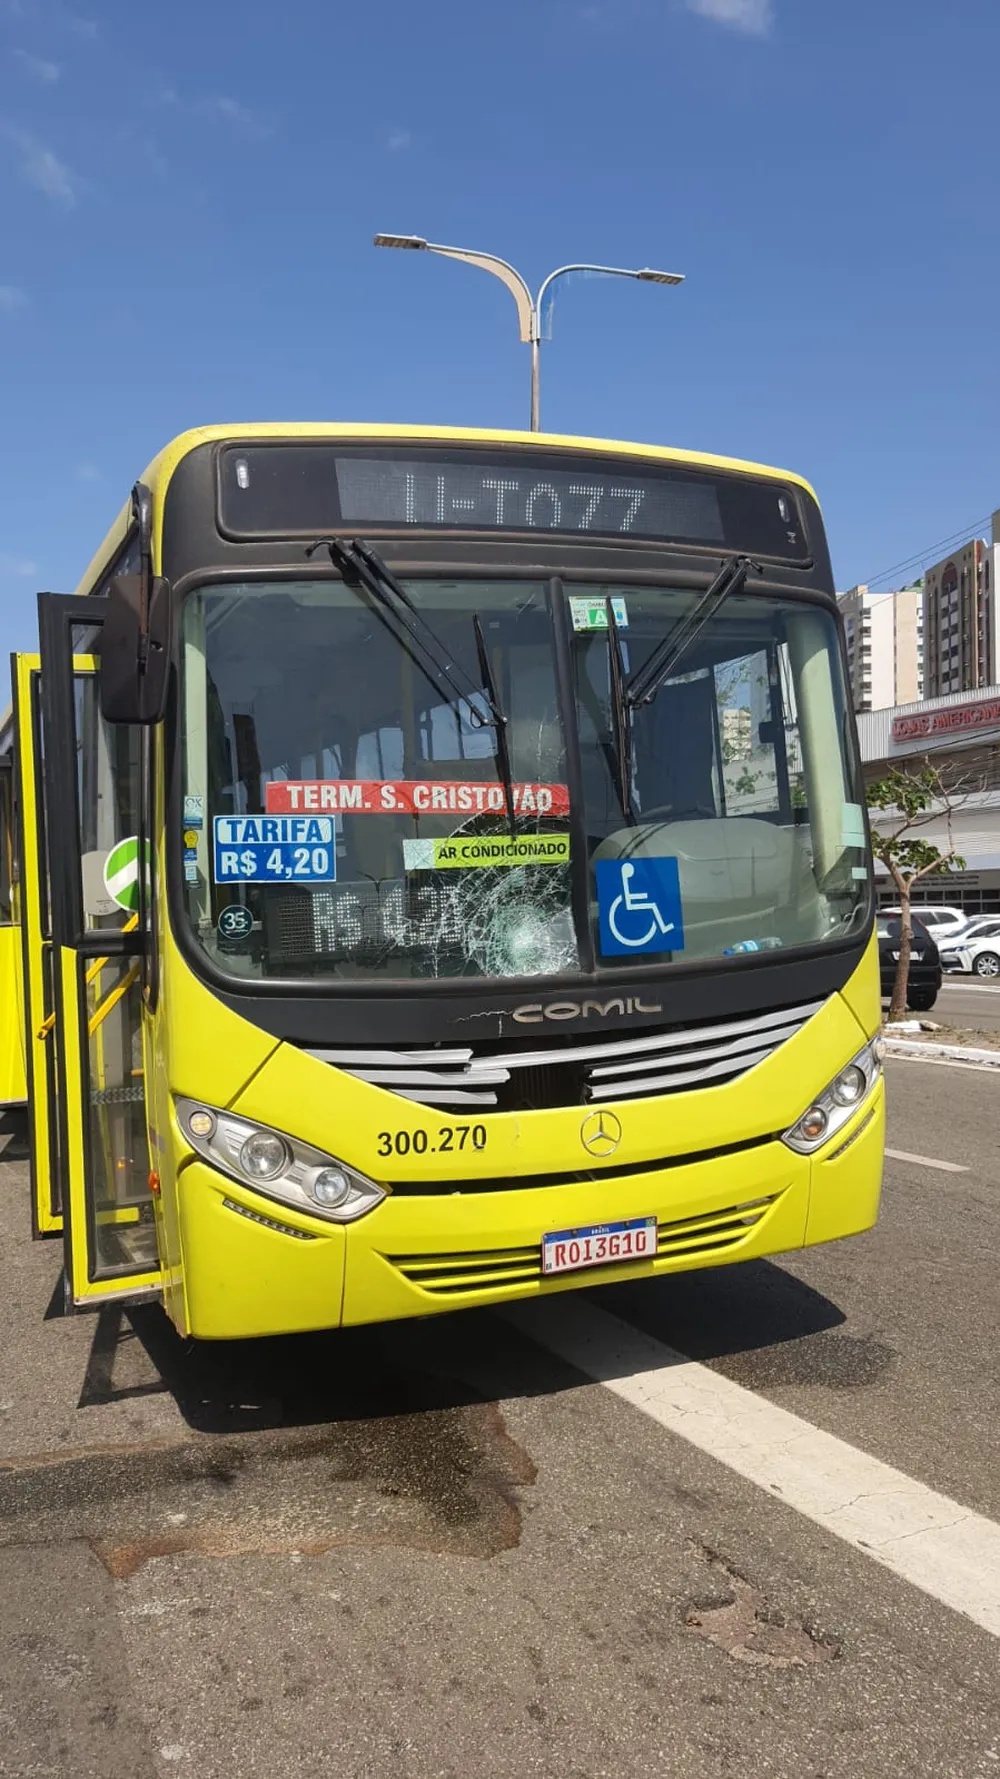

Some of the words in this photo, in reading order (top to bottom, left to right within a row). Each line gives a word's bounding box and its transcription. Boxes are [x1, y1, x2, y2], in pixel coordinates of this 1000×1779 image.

[286, 784, 371, 809] TERM.
[381, 785, 404, 809] S.
[226, 819, 322, 843] TARIFA
[220, 850, 256, 876] R$
[266, 848, 329, 879] 4,20
[437, 844, 458, 860] AR
[460, 841, 567, 859] CONDICIONADO
[512, 996, 662, 1023] COMIL
[376, 1124, 488, 1157] 300.270
[555, 1230, 646, 1267] ROI3G10
